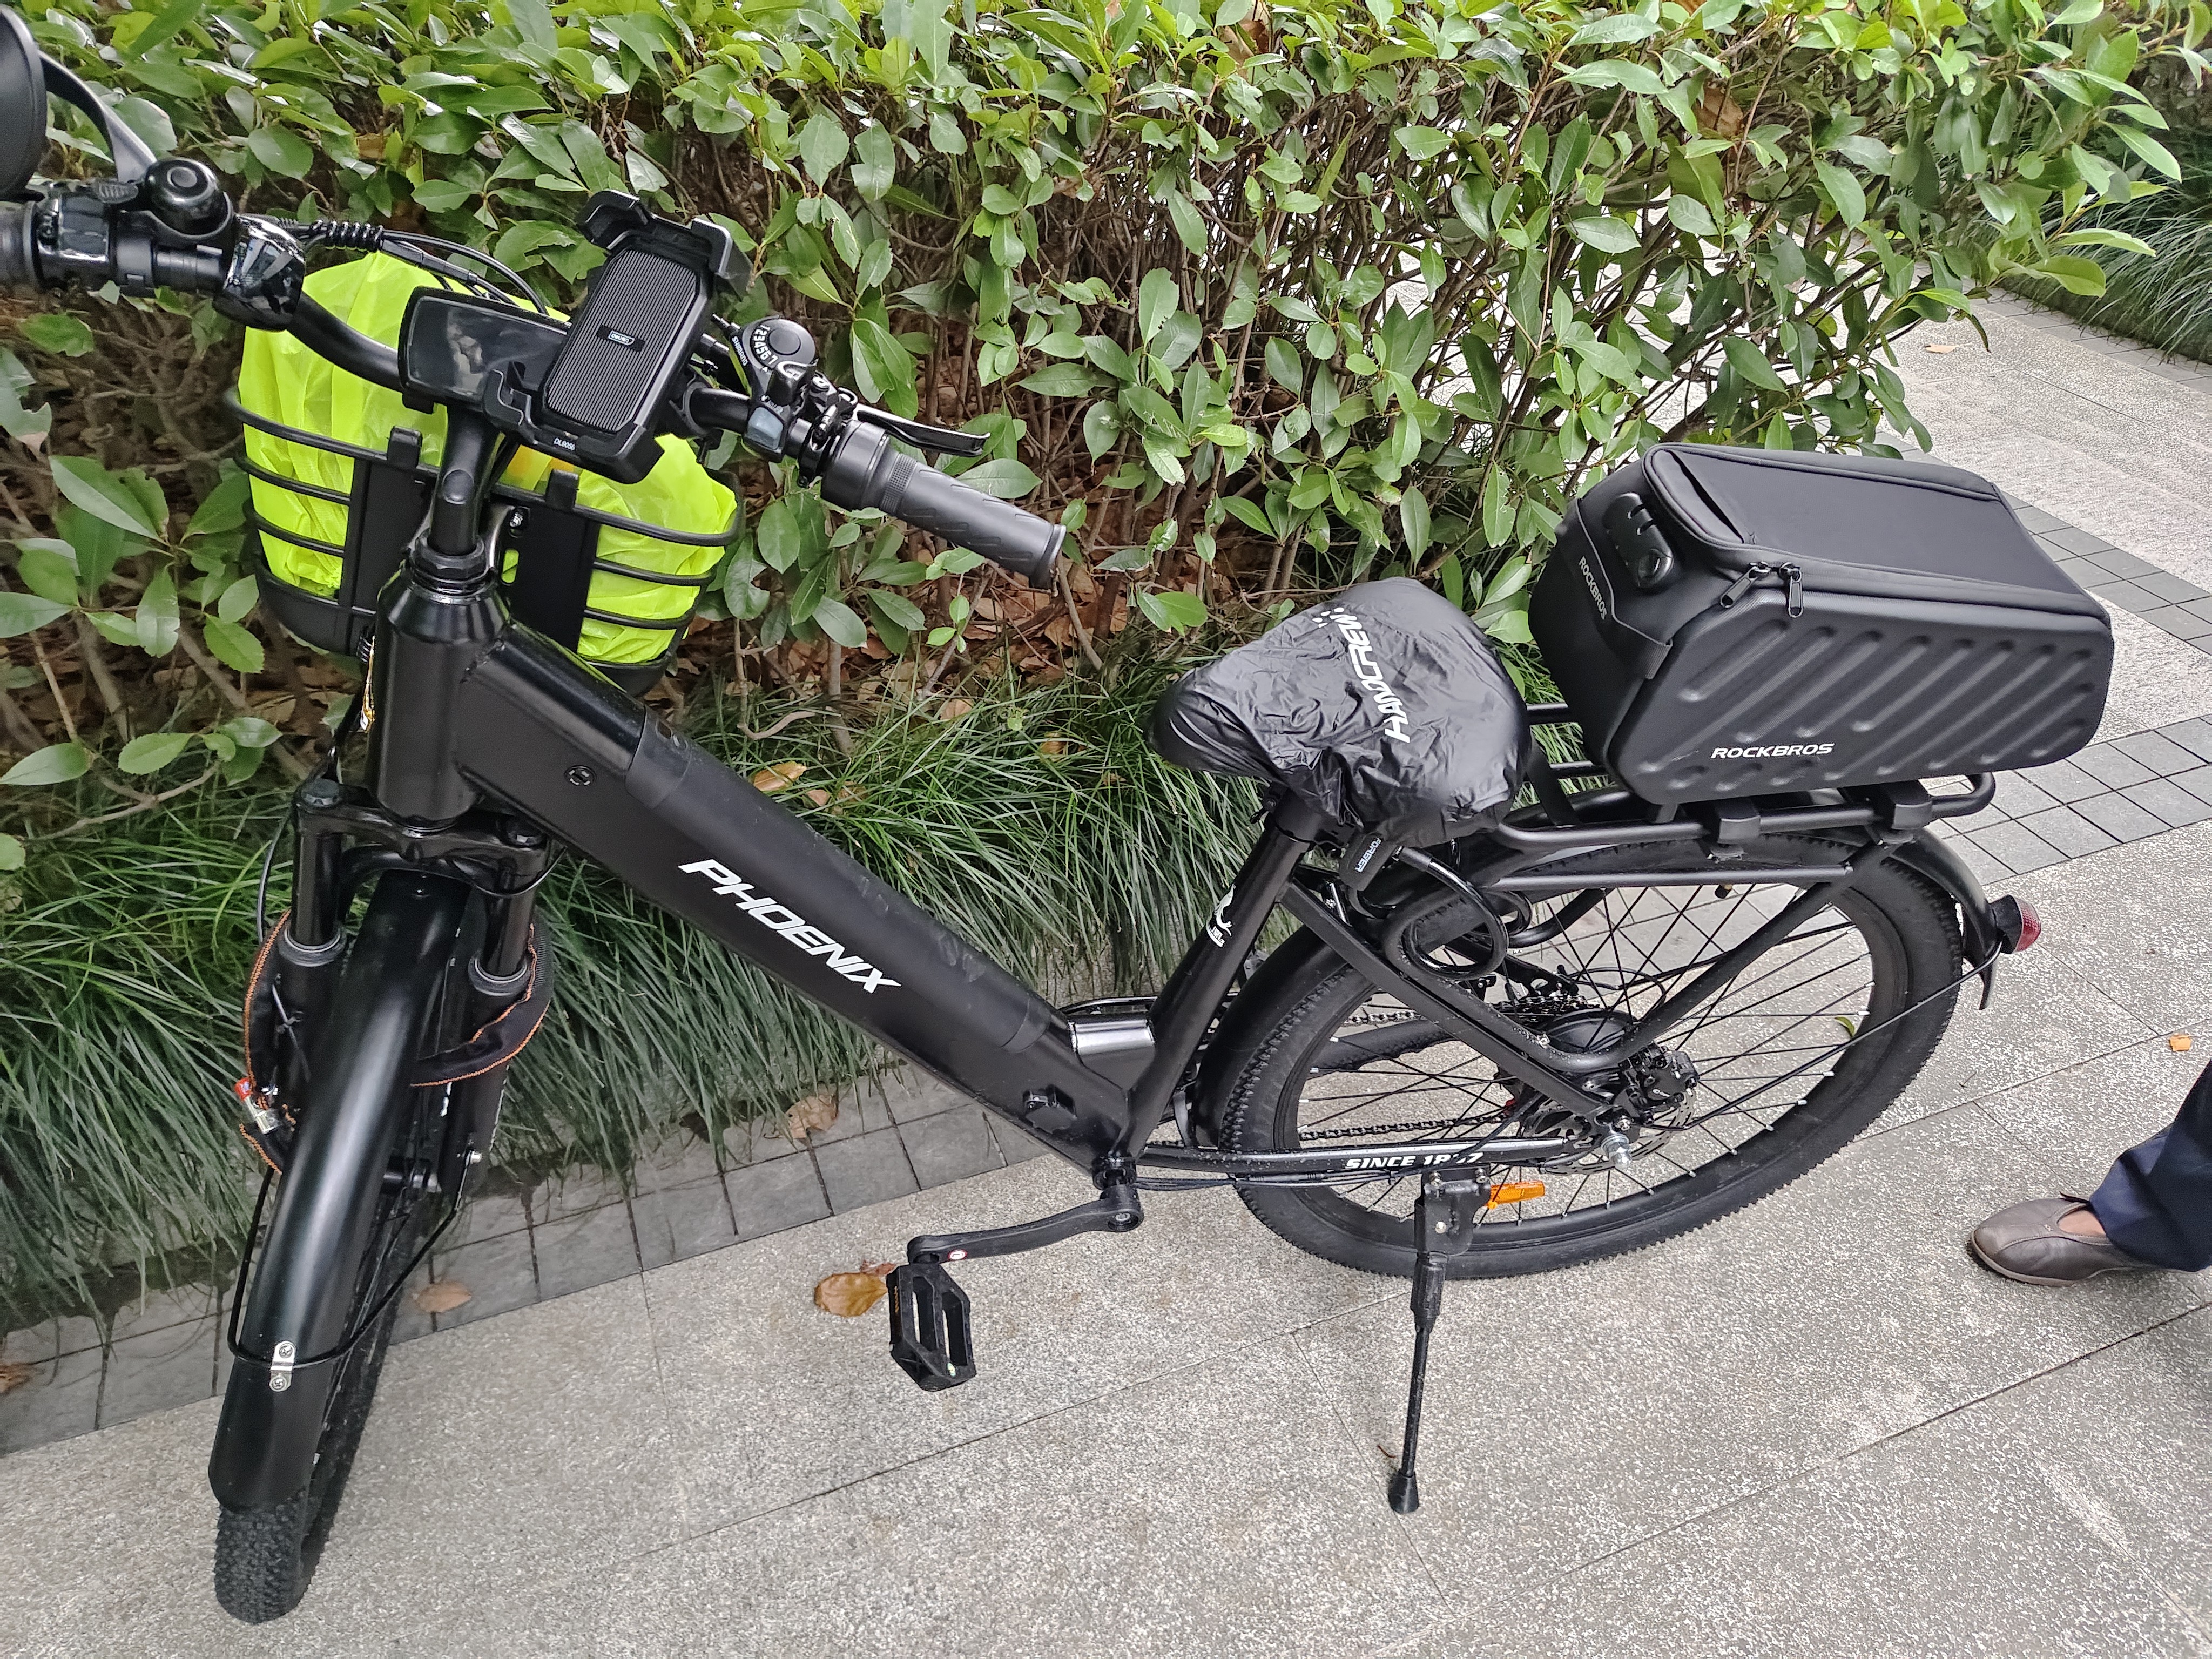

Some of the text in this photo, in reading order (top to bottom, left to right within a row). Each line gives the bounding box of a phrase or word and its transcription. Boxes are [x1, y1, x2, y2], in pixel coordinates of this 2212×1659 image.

[732, 336, 748, 366] SHIMANO
[1579, 556, 1607, 620] ROCKBROS
[1329, 614, 1410, 744] HANDCREW
[1710, 743, 1835, 759] ROCKBROS
[678, 859, 902, 994] PHOENIX
[1345, 1156, 1417, 1169] SINCE
